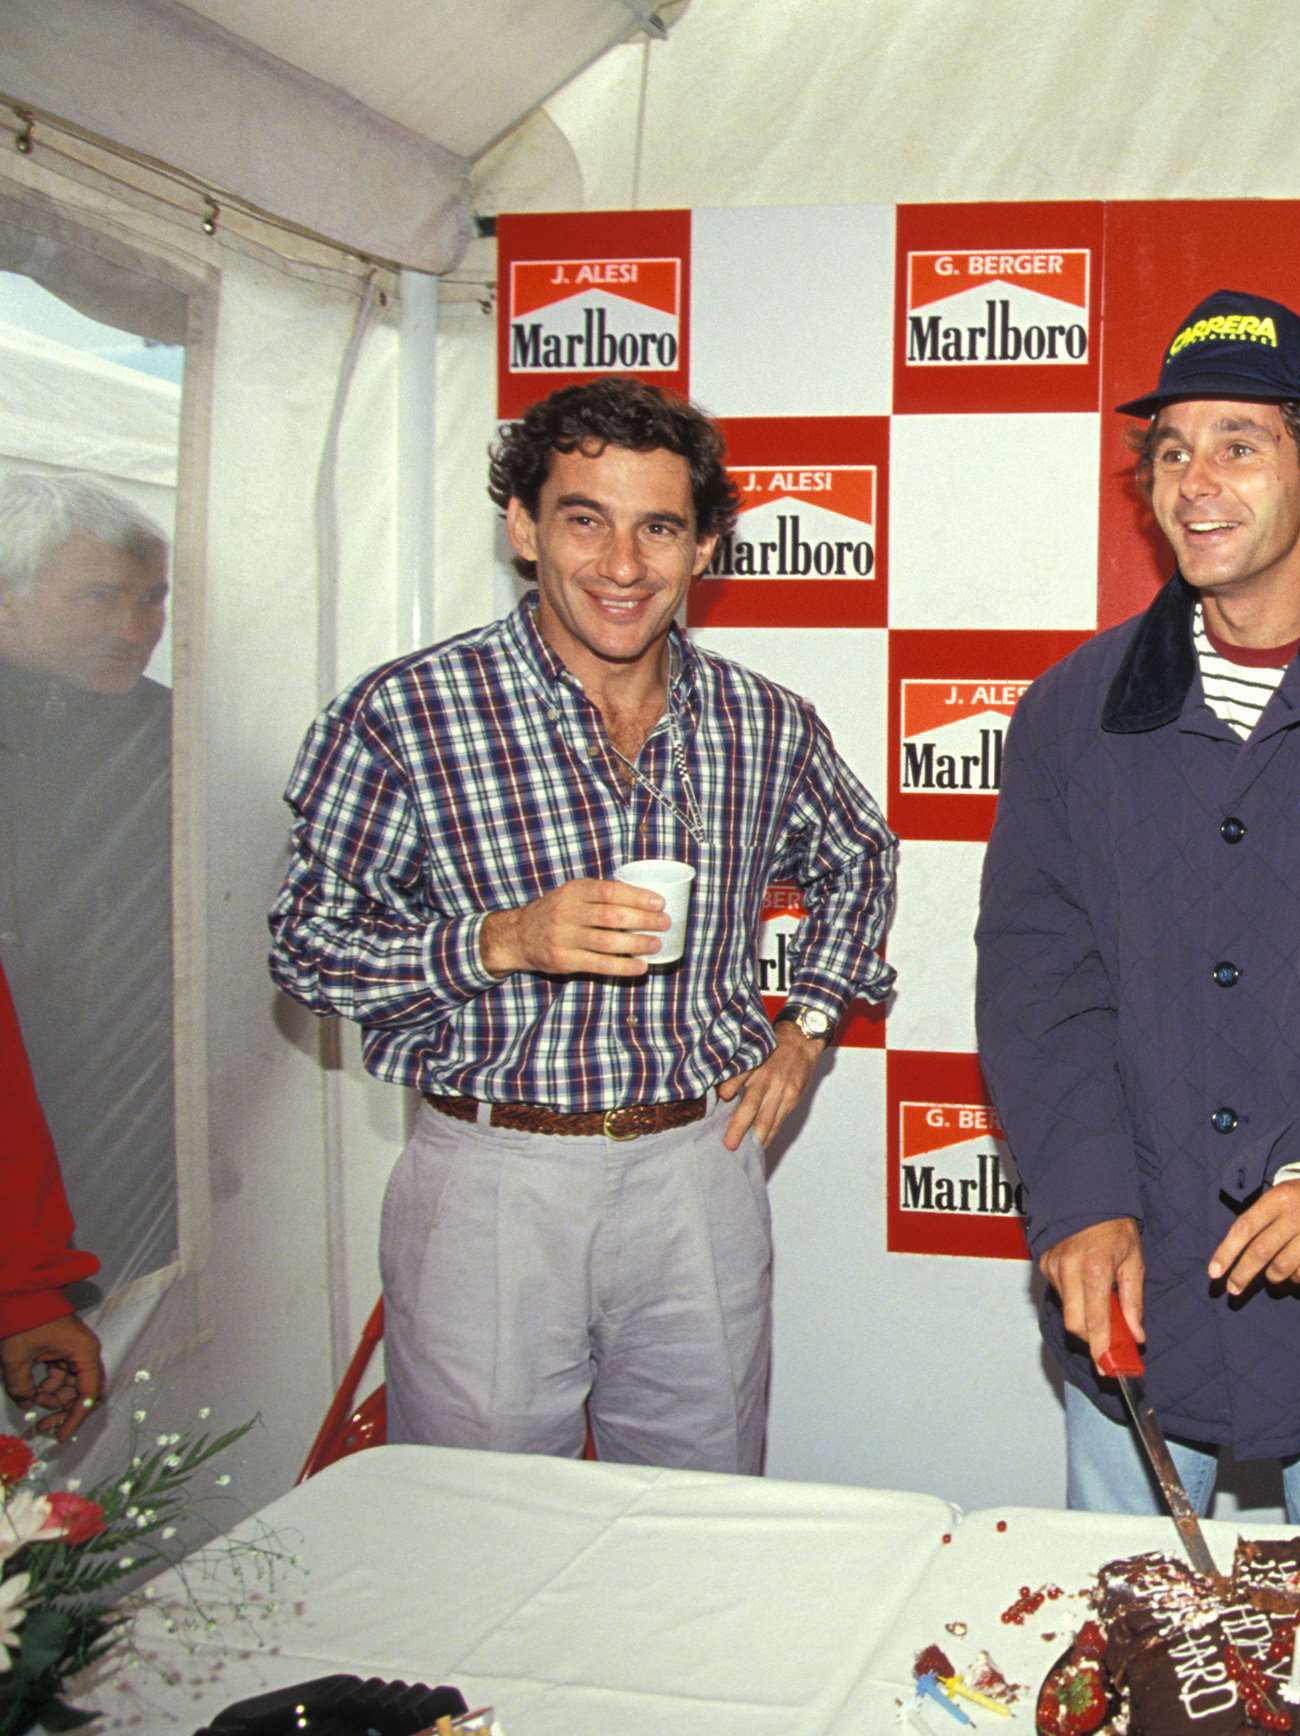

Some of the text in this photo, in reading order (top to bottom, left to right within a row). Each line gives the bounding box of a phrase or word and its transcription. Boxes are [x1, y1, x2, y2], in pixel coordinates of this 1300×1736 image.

[551, 264, 638, 284] J. ALESI
[934, 255, 1064, 276] G. BERGER
[511, 308, 677, 367] Marlboro
[908, 300, 1087, 361] Marlboro
[743, 472, 832, 491] J. ALESI
[945, 686, 964, 704] J.
[925, 1108, 951, 1127] G.
